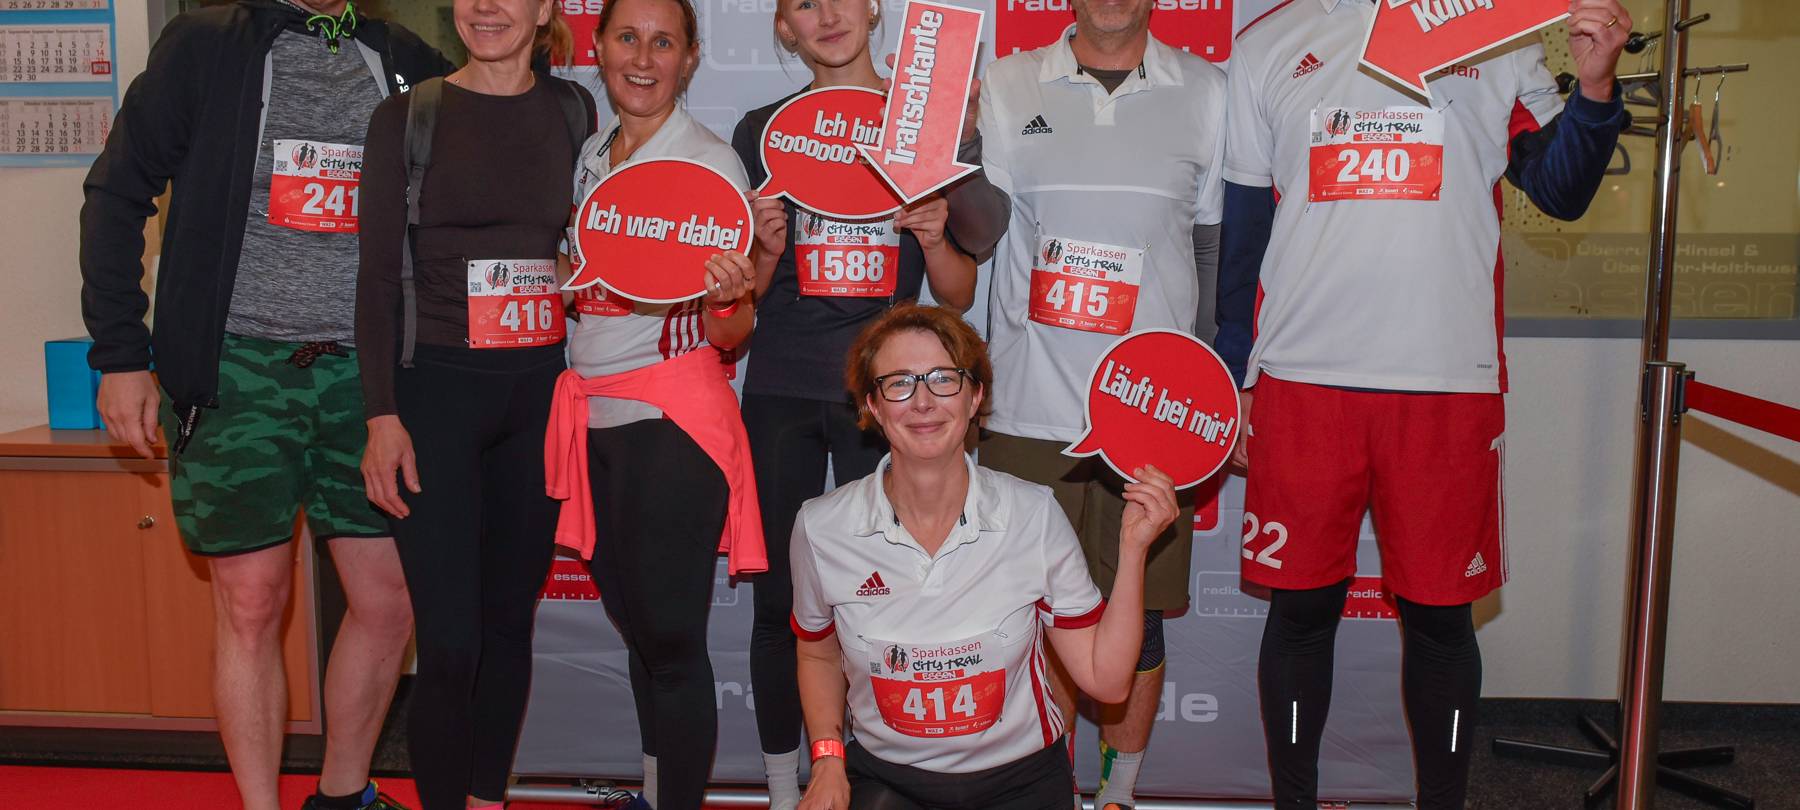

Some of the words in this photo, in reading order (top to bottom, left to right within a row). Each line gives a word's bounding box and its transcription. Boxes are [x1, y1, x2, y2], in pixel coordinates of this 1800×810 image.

[1293, 62, 1324, 78] adidas
[884, 9, 944, 166] Tratschtante
[813, 110, 848, 138] Ich
[851, 117, 883, 145] bin
[1021, 127, 1053, 136] adidas
[1355, 110, 1423, 121] Sparkassen
[1336, 148, 1410, 183] 240
[302, 182, 359, 217] 241
[586, 201, 622, 235] Ich
[626, 215, 675, 242] war
[678, 214, 744, 250] dabei
[806, 249, 885, 282] 1588
[1067, 242, 1127, 261] Sparkassen
[1045, 280, 1110, 317] 415
[500, 299, 553, 332] 416
[1099, 359, 1154, 414] Läuft
[1153, 387, 1193, 429] bei
[1188, 412, 1235, 447] mir!
[1242, 511, 1288, 570] 22
[1465, 563, 1487, 578] adidas
[856, 588, 890, 596] adidas
[1203, 585, 1241, 596] radio
[1346, 589, 1383, 599] radio
[912, 641, 982, 660] Sparkassen
[902, 683, 978, 721] 414
